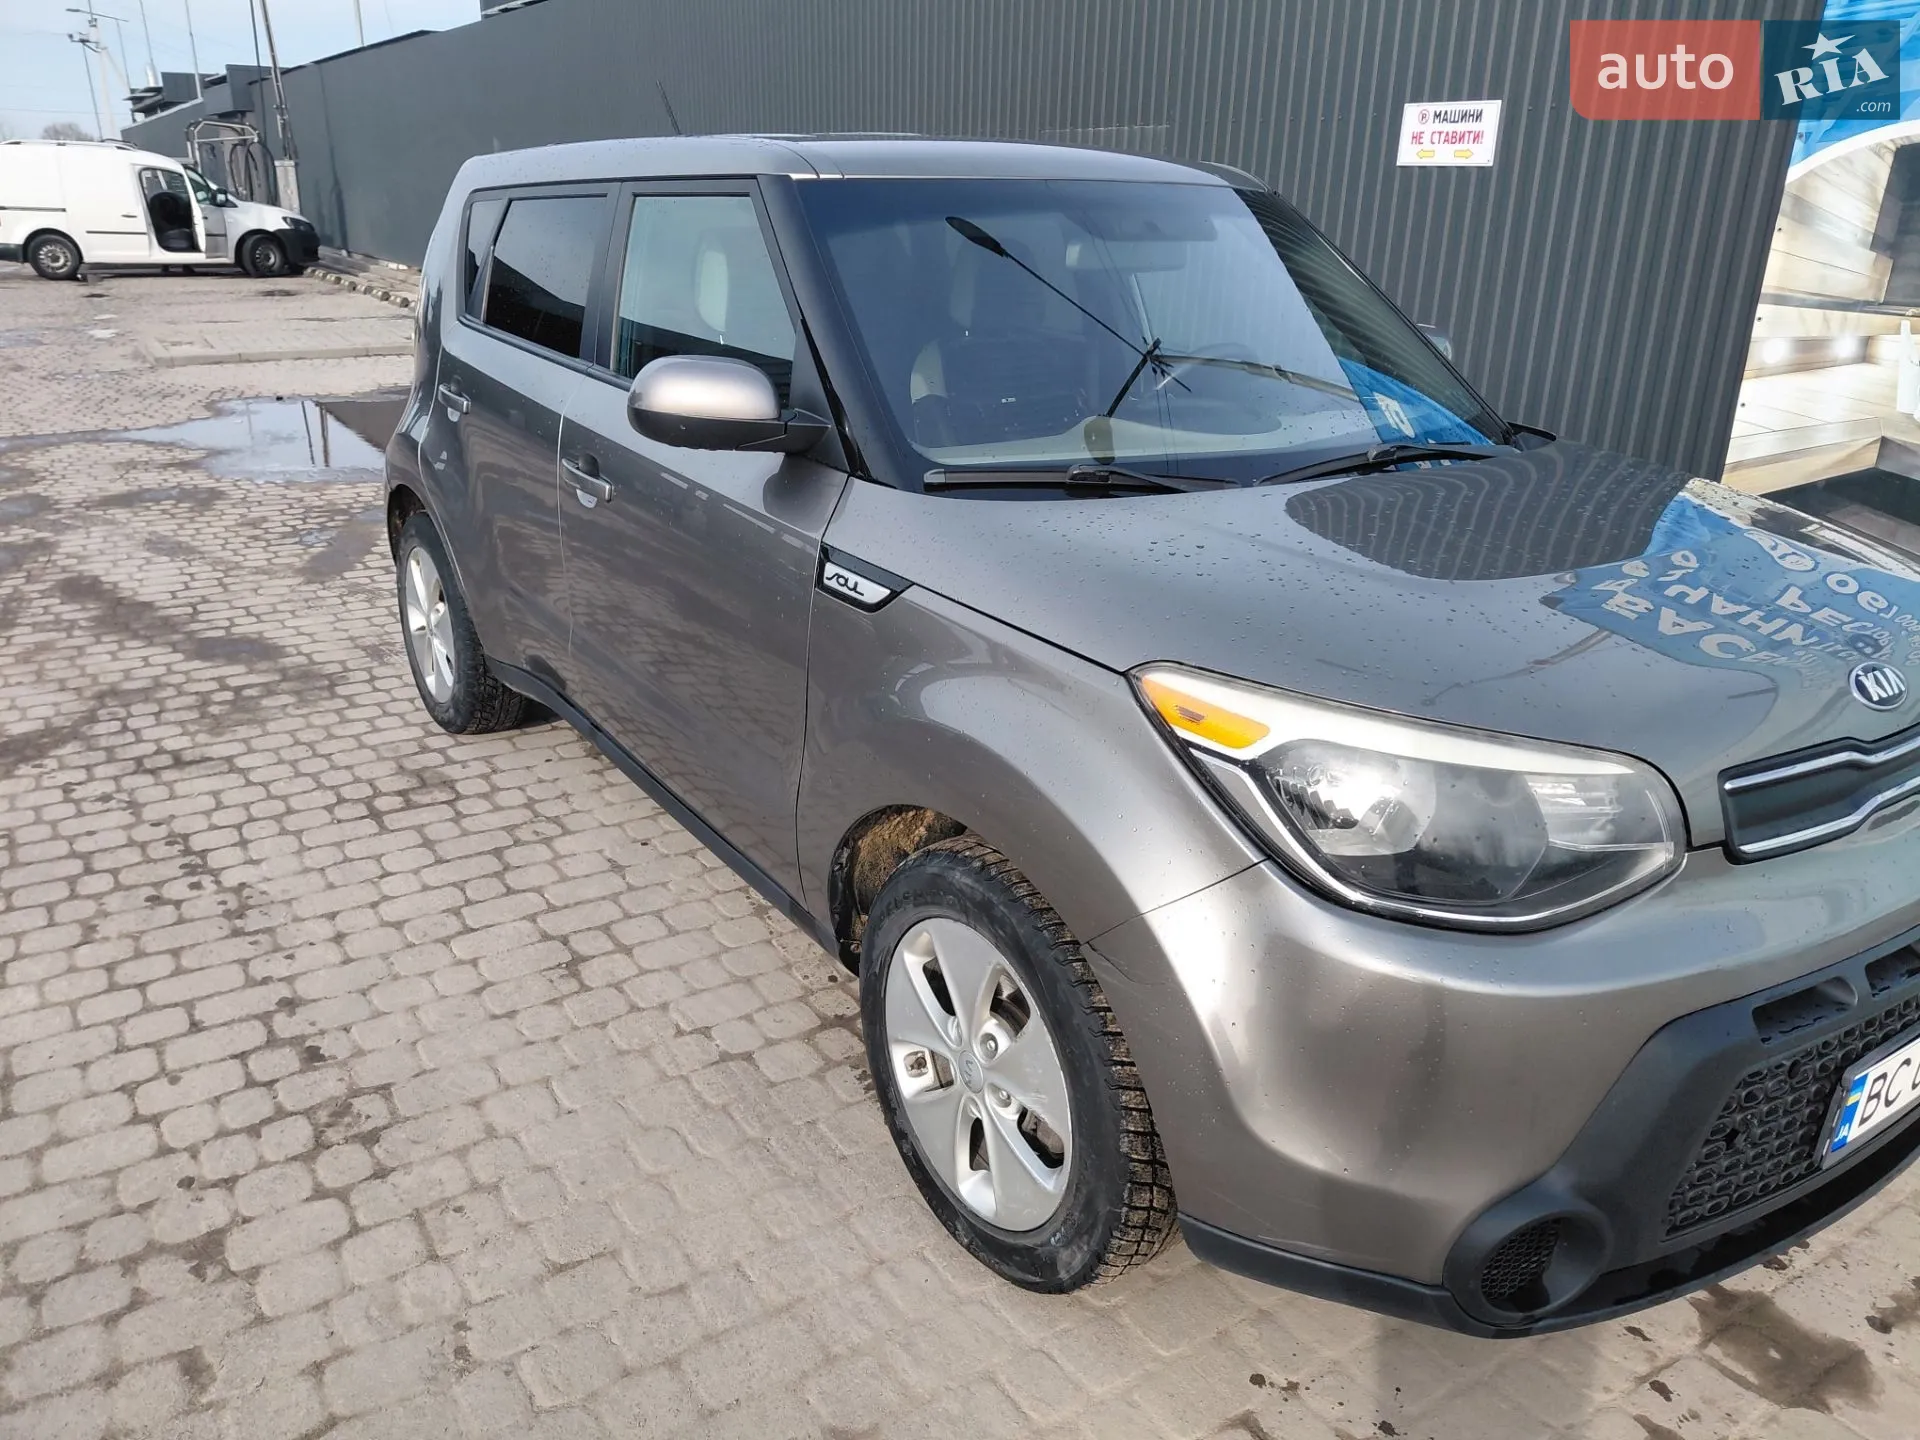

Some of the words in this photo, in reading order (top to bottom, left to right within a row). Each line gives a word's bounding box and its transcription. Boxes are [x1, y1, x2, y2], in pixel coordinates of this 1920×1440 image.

[1433, 109, 1483, 124] МАШИНИ
[1411, 131, 1425, 145] НЕ
[1431, 130, 1484, 145] СТАВИТИ!
[1857, 668, 1905, 701] KIA
